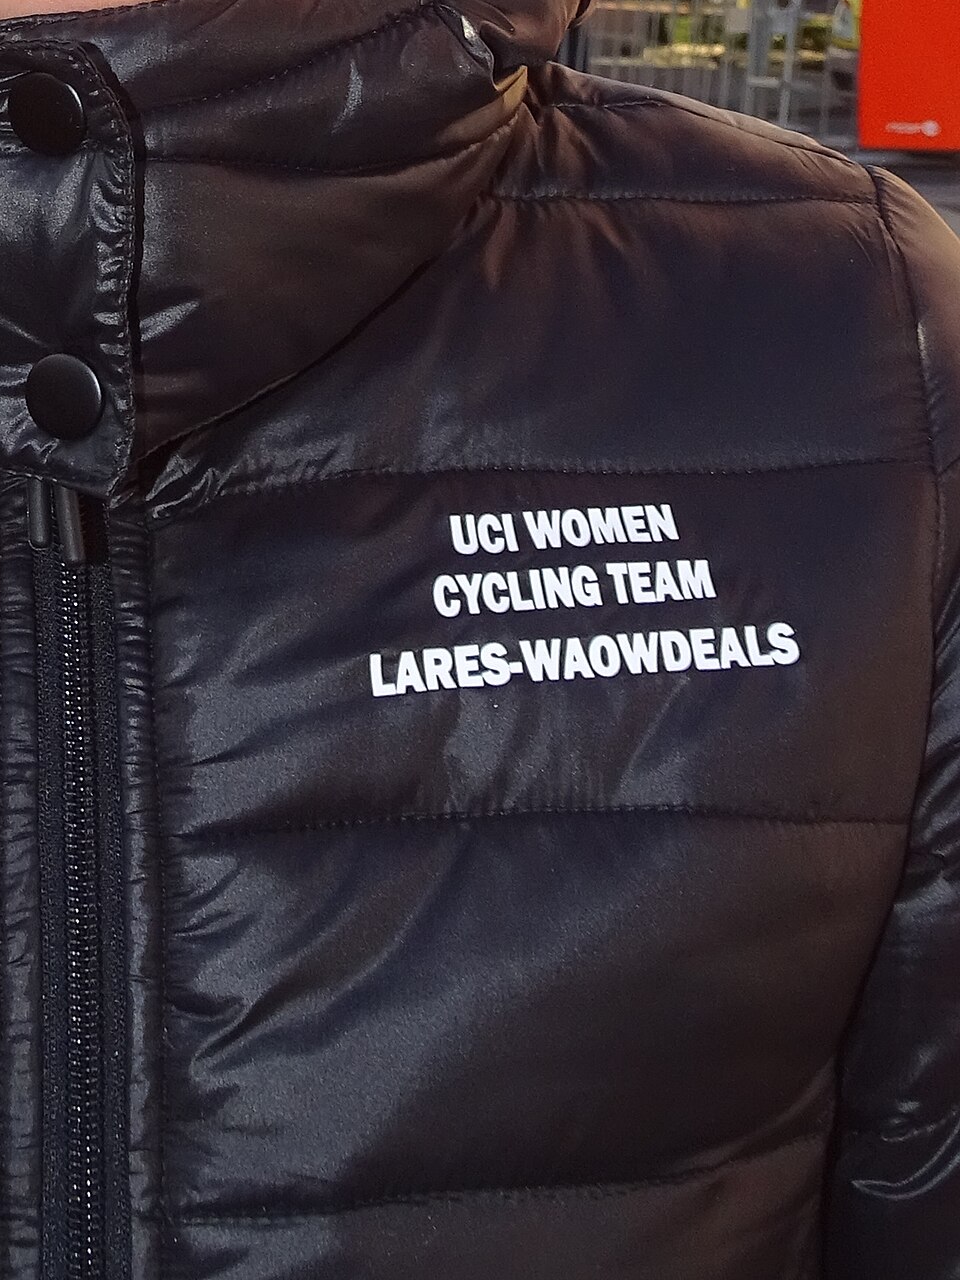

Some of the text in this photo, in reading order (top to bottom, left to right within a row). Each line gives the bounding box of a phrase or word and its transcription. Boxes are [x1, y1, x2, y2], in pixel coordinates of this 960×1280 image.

[449, 503, 680, 556] UCI WOMEN
[432, 559, 717, 618] CYCLING TEAM
[369, 621, 801, 698] LARES-WAOWDEALS
